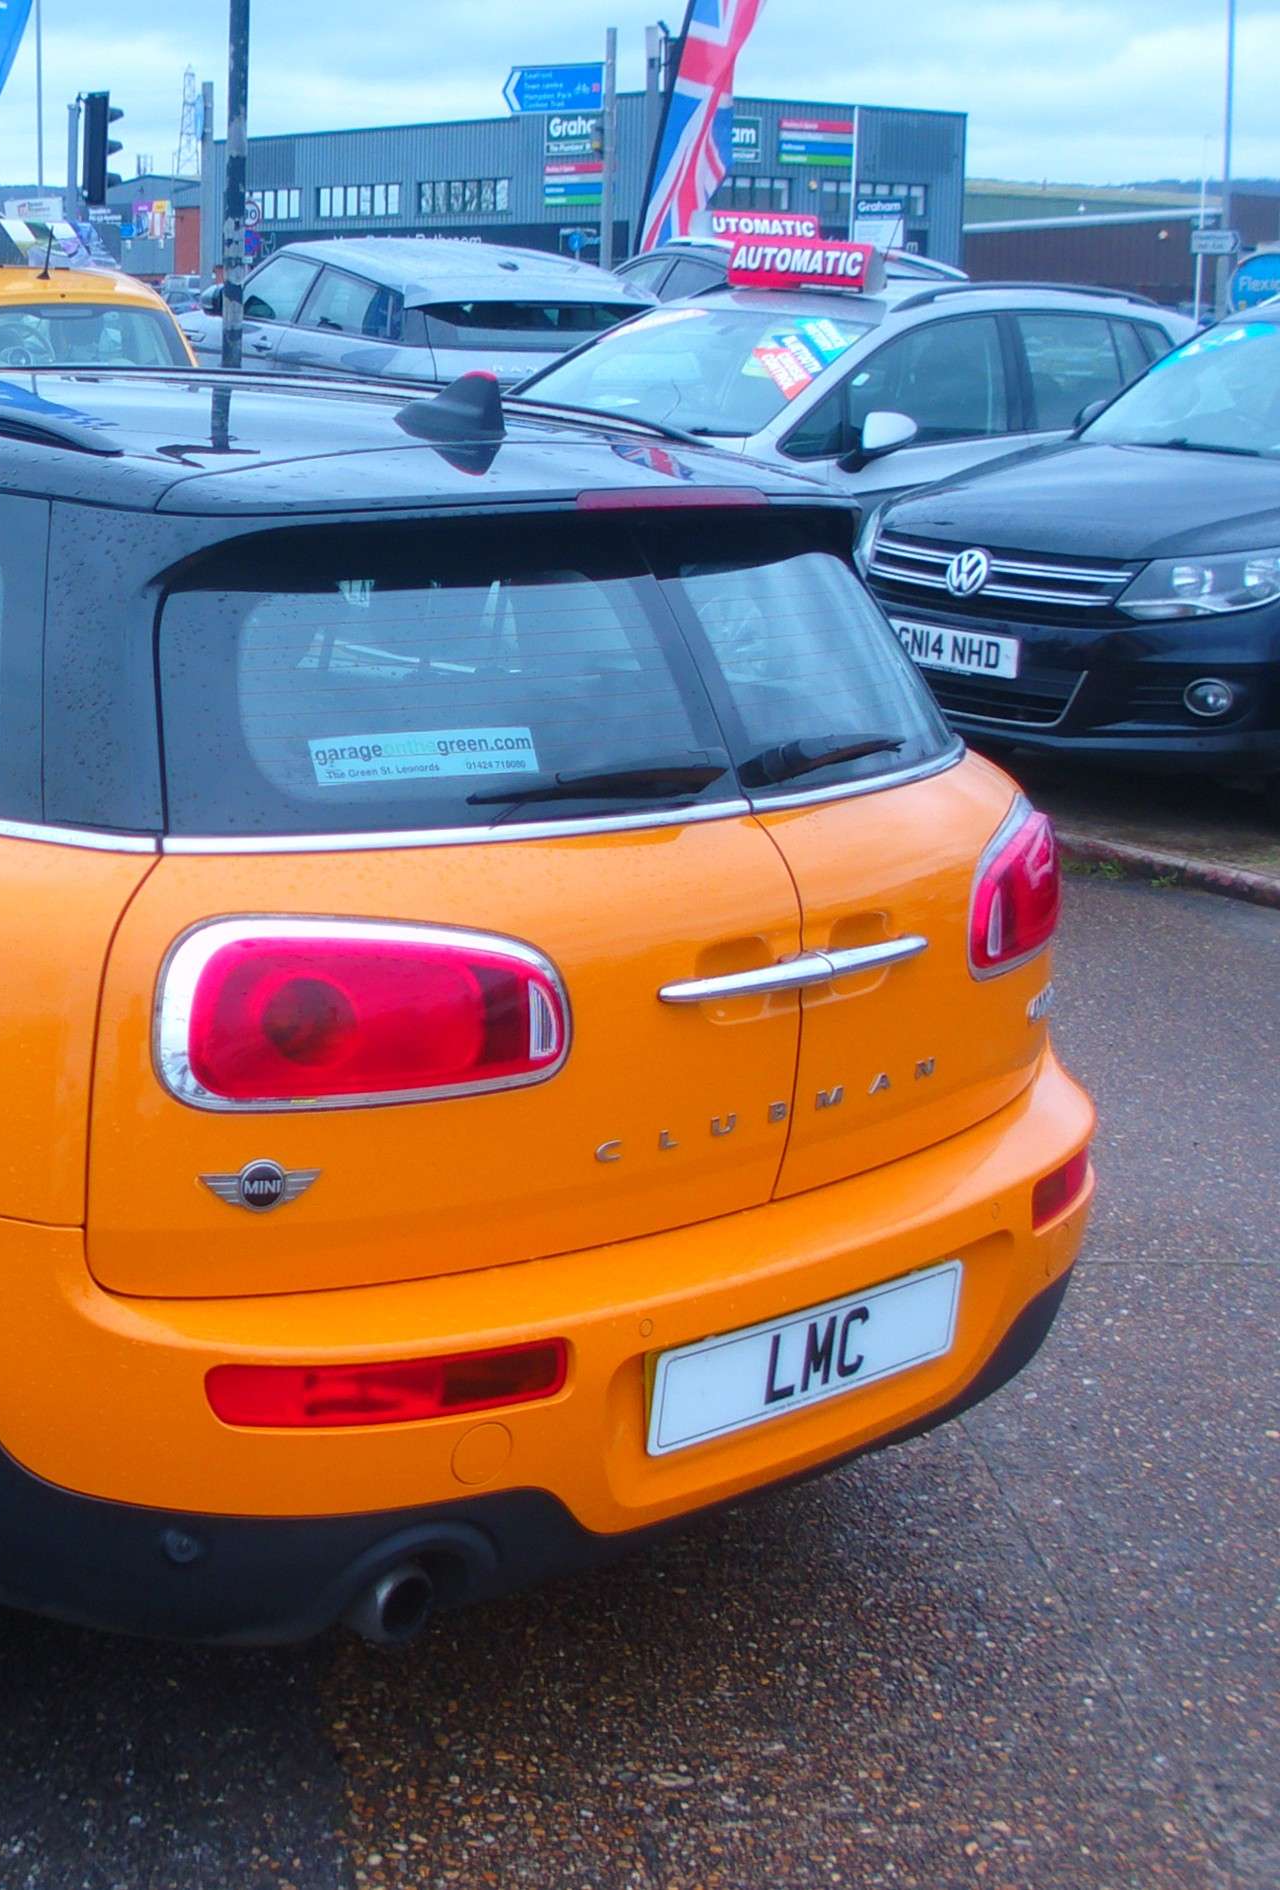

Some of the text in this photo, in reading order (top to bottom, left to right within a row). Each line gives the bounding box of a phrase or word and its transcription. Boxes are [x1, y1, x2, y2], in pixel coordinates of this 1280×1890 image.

[549, 116, 596, 137] Grah
[857, 201, 901, 213] Graham
[713, 216, 815, 237] UTOMATIC
[732, 245, 864, 277] AUTOMATIC
[898, 626, 1001, 670] GN14 NHD
[327, 770, 346, 780] The
[348, 767, 378, 778] Green
[380, 765, 394, 776] St.
[595, 1056, 936, 1162] CLUBMAN
[243, 1180, 282, 1195] MINI
[764, 1305, 870, 1406] LMC
